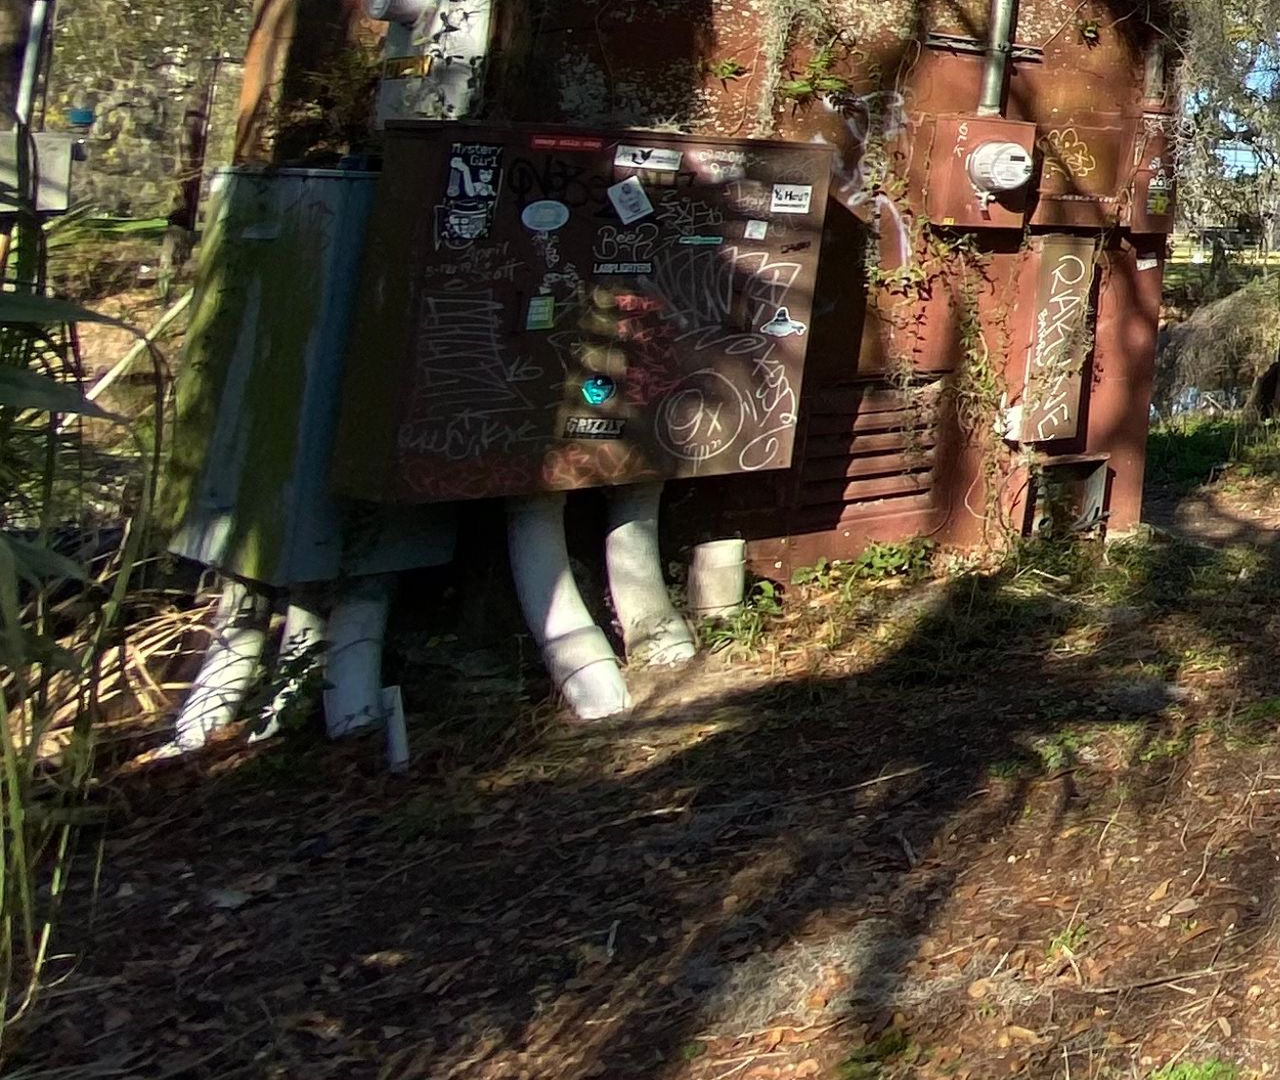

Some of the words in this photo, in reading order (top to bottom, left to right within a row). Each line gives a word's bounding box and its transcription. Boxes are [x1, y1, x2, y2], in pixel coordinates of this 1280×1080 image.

[452, 142, 503, 160] Mystery
[470, 154, 498, 168] Girl
[566, 416, 626, 434] GRIZZLY
